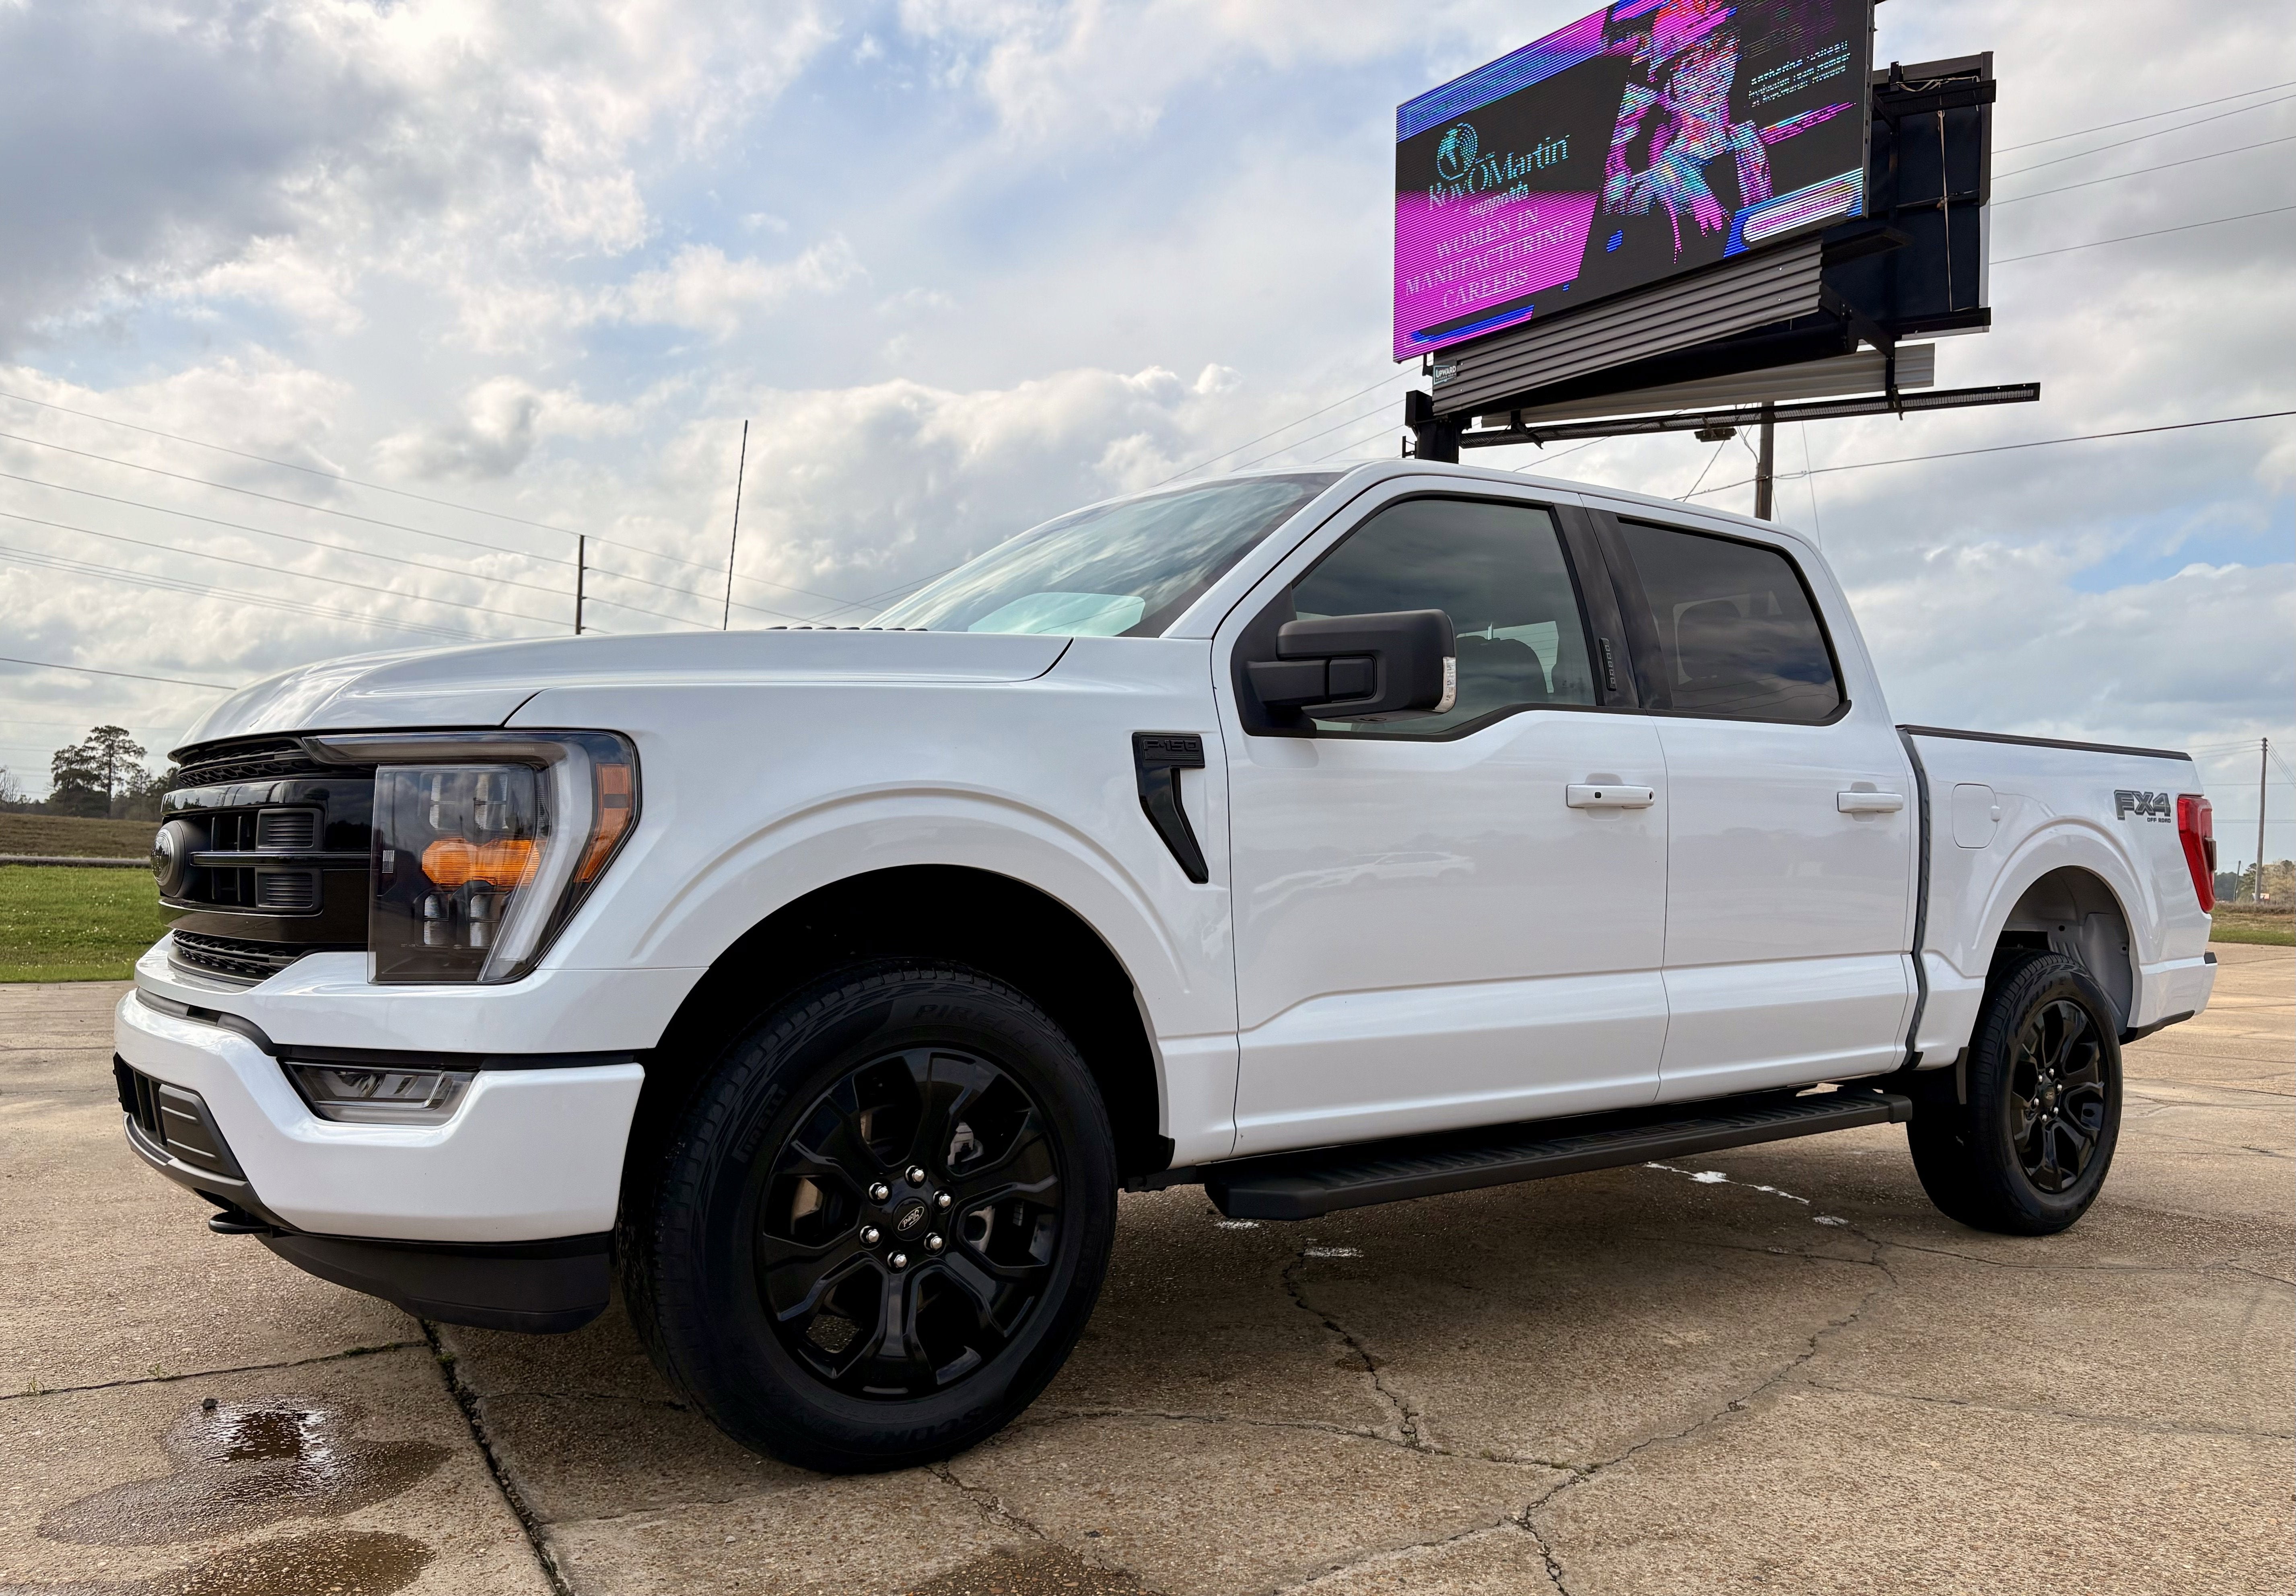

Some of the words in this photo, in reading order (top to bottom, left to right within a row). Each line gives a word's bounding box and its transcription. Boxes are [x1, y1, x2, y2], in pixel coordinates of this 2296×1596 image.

[1436, 218, 1510, 259] WOMEN
[1516, 206, 1538, 232] IN
[1405, 221, 1573, 297] MANUFACTURING
[1443, 265, 1529, 309] CAREERS
[1143, 739, 1200, 752] F-150
[2114, 790, 2171, 821] FX4
[913, 1002, 1046, 1053] PIRELLI
[902, 1208, 920, 1228] Ford
